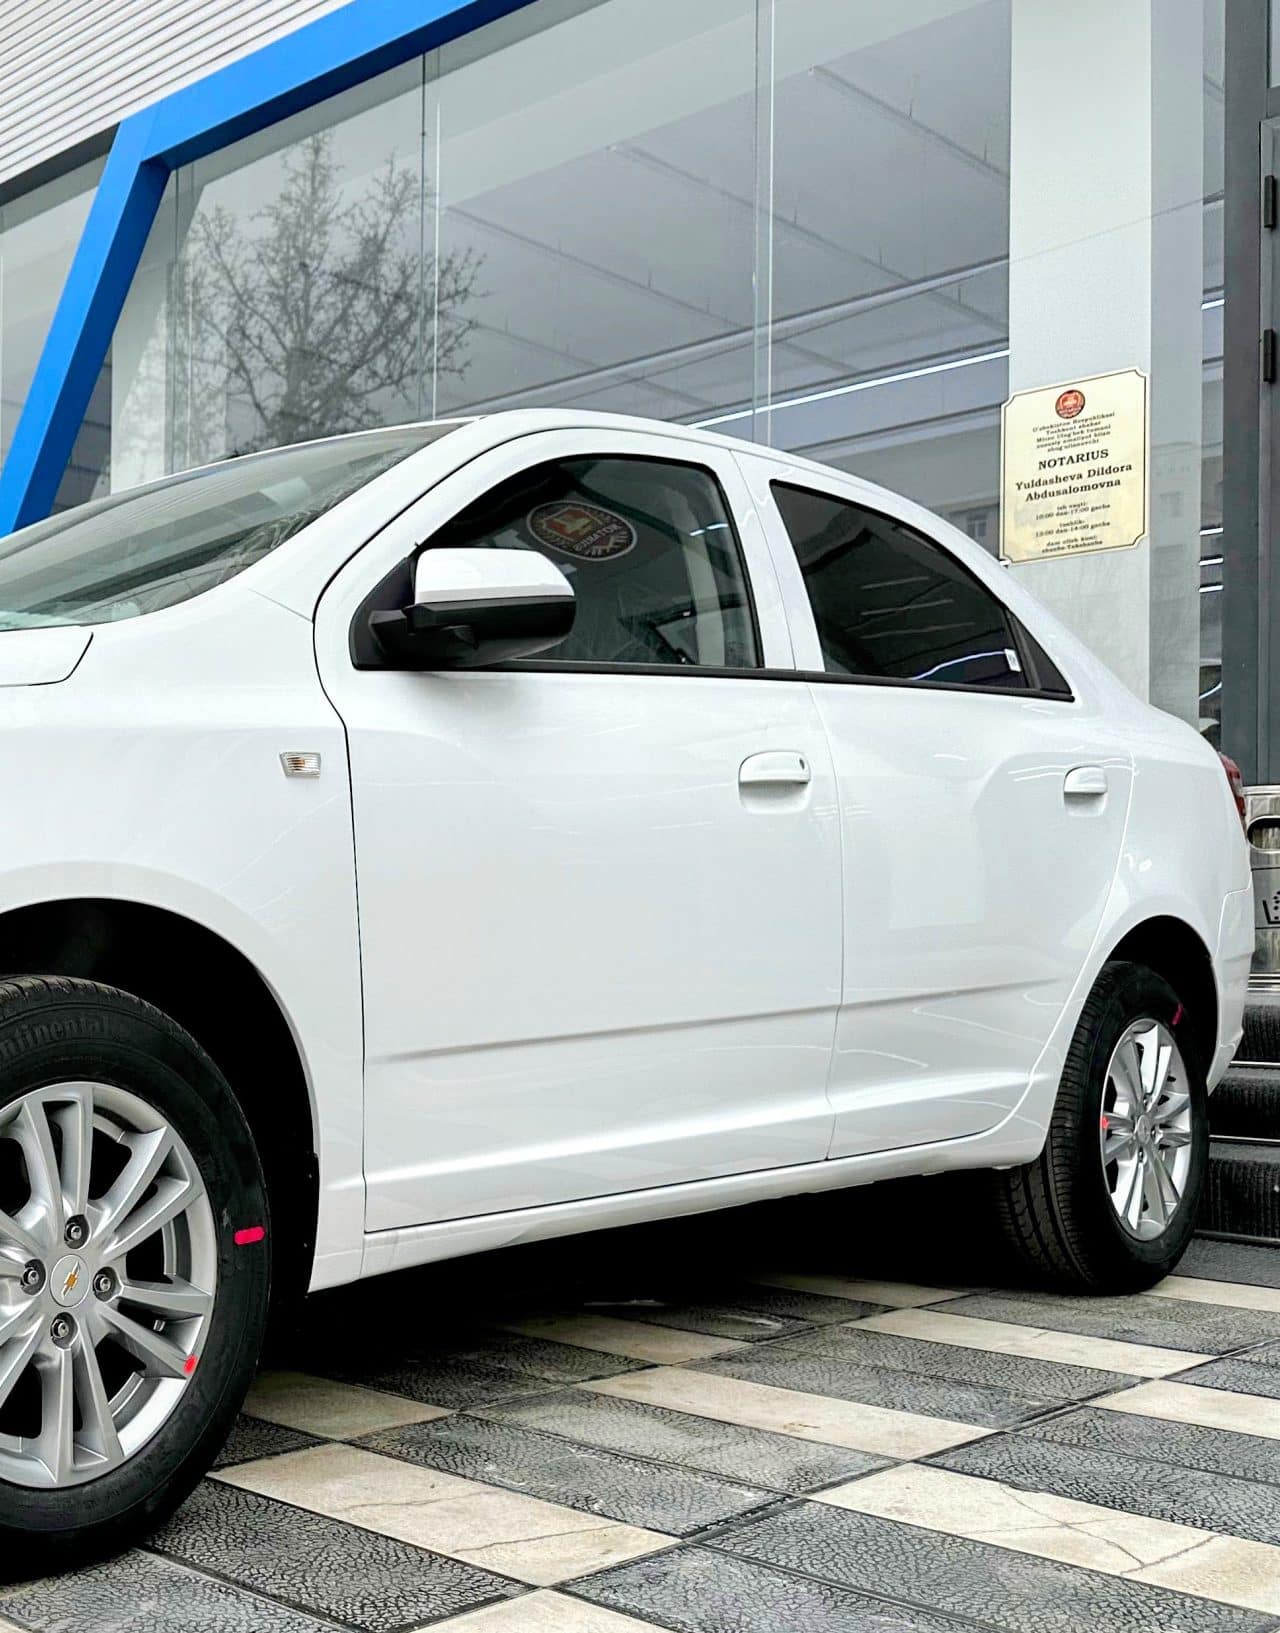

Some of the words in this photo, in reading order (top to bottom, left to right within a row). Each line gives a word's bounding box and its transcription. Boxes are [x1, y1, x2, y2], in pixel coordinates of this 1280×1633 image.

[1038, 448, 1109, 471] NOTARIUS
[1016, 472, 1083, 491] Yuldasheva
[1087, 464, 1132, 478] Dildora
[1025, 479, 1121, 502] Abdusalomovna
